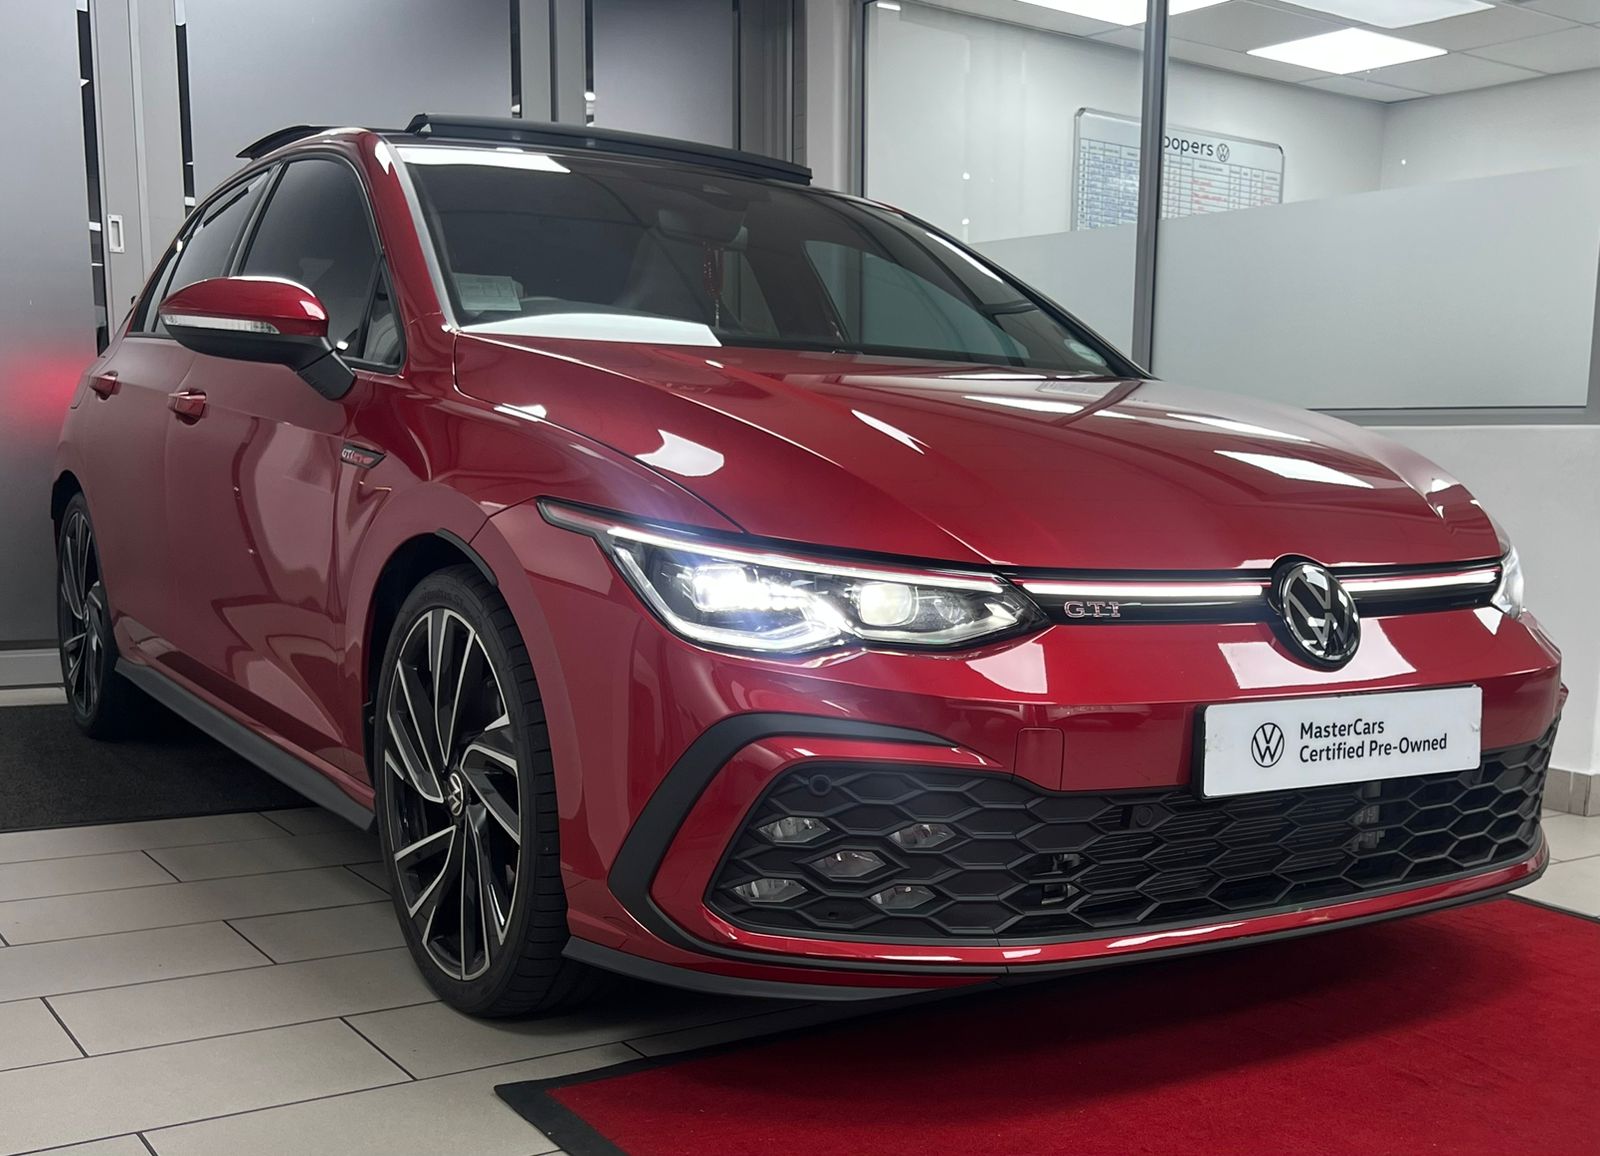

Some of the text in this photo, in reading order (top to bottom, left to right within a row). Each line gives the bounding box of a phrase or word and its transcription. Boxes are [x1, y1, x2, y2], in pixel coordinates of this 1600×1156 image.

[1164, 135, 1214, 156] oopers
[1064, 600, 1121, 618] GTI
[1300, 718, 1384, 740] MasterCars
[1299, 732, 1447, 763] Certified Pre-Owned
